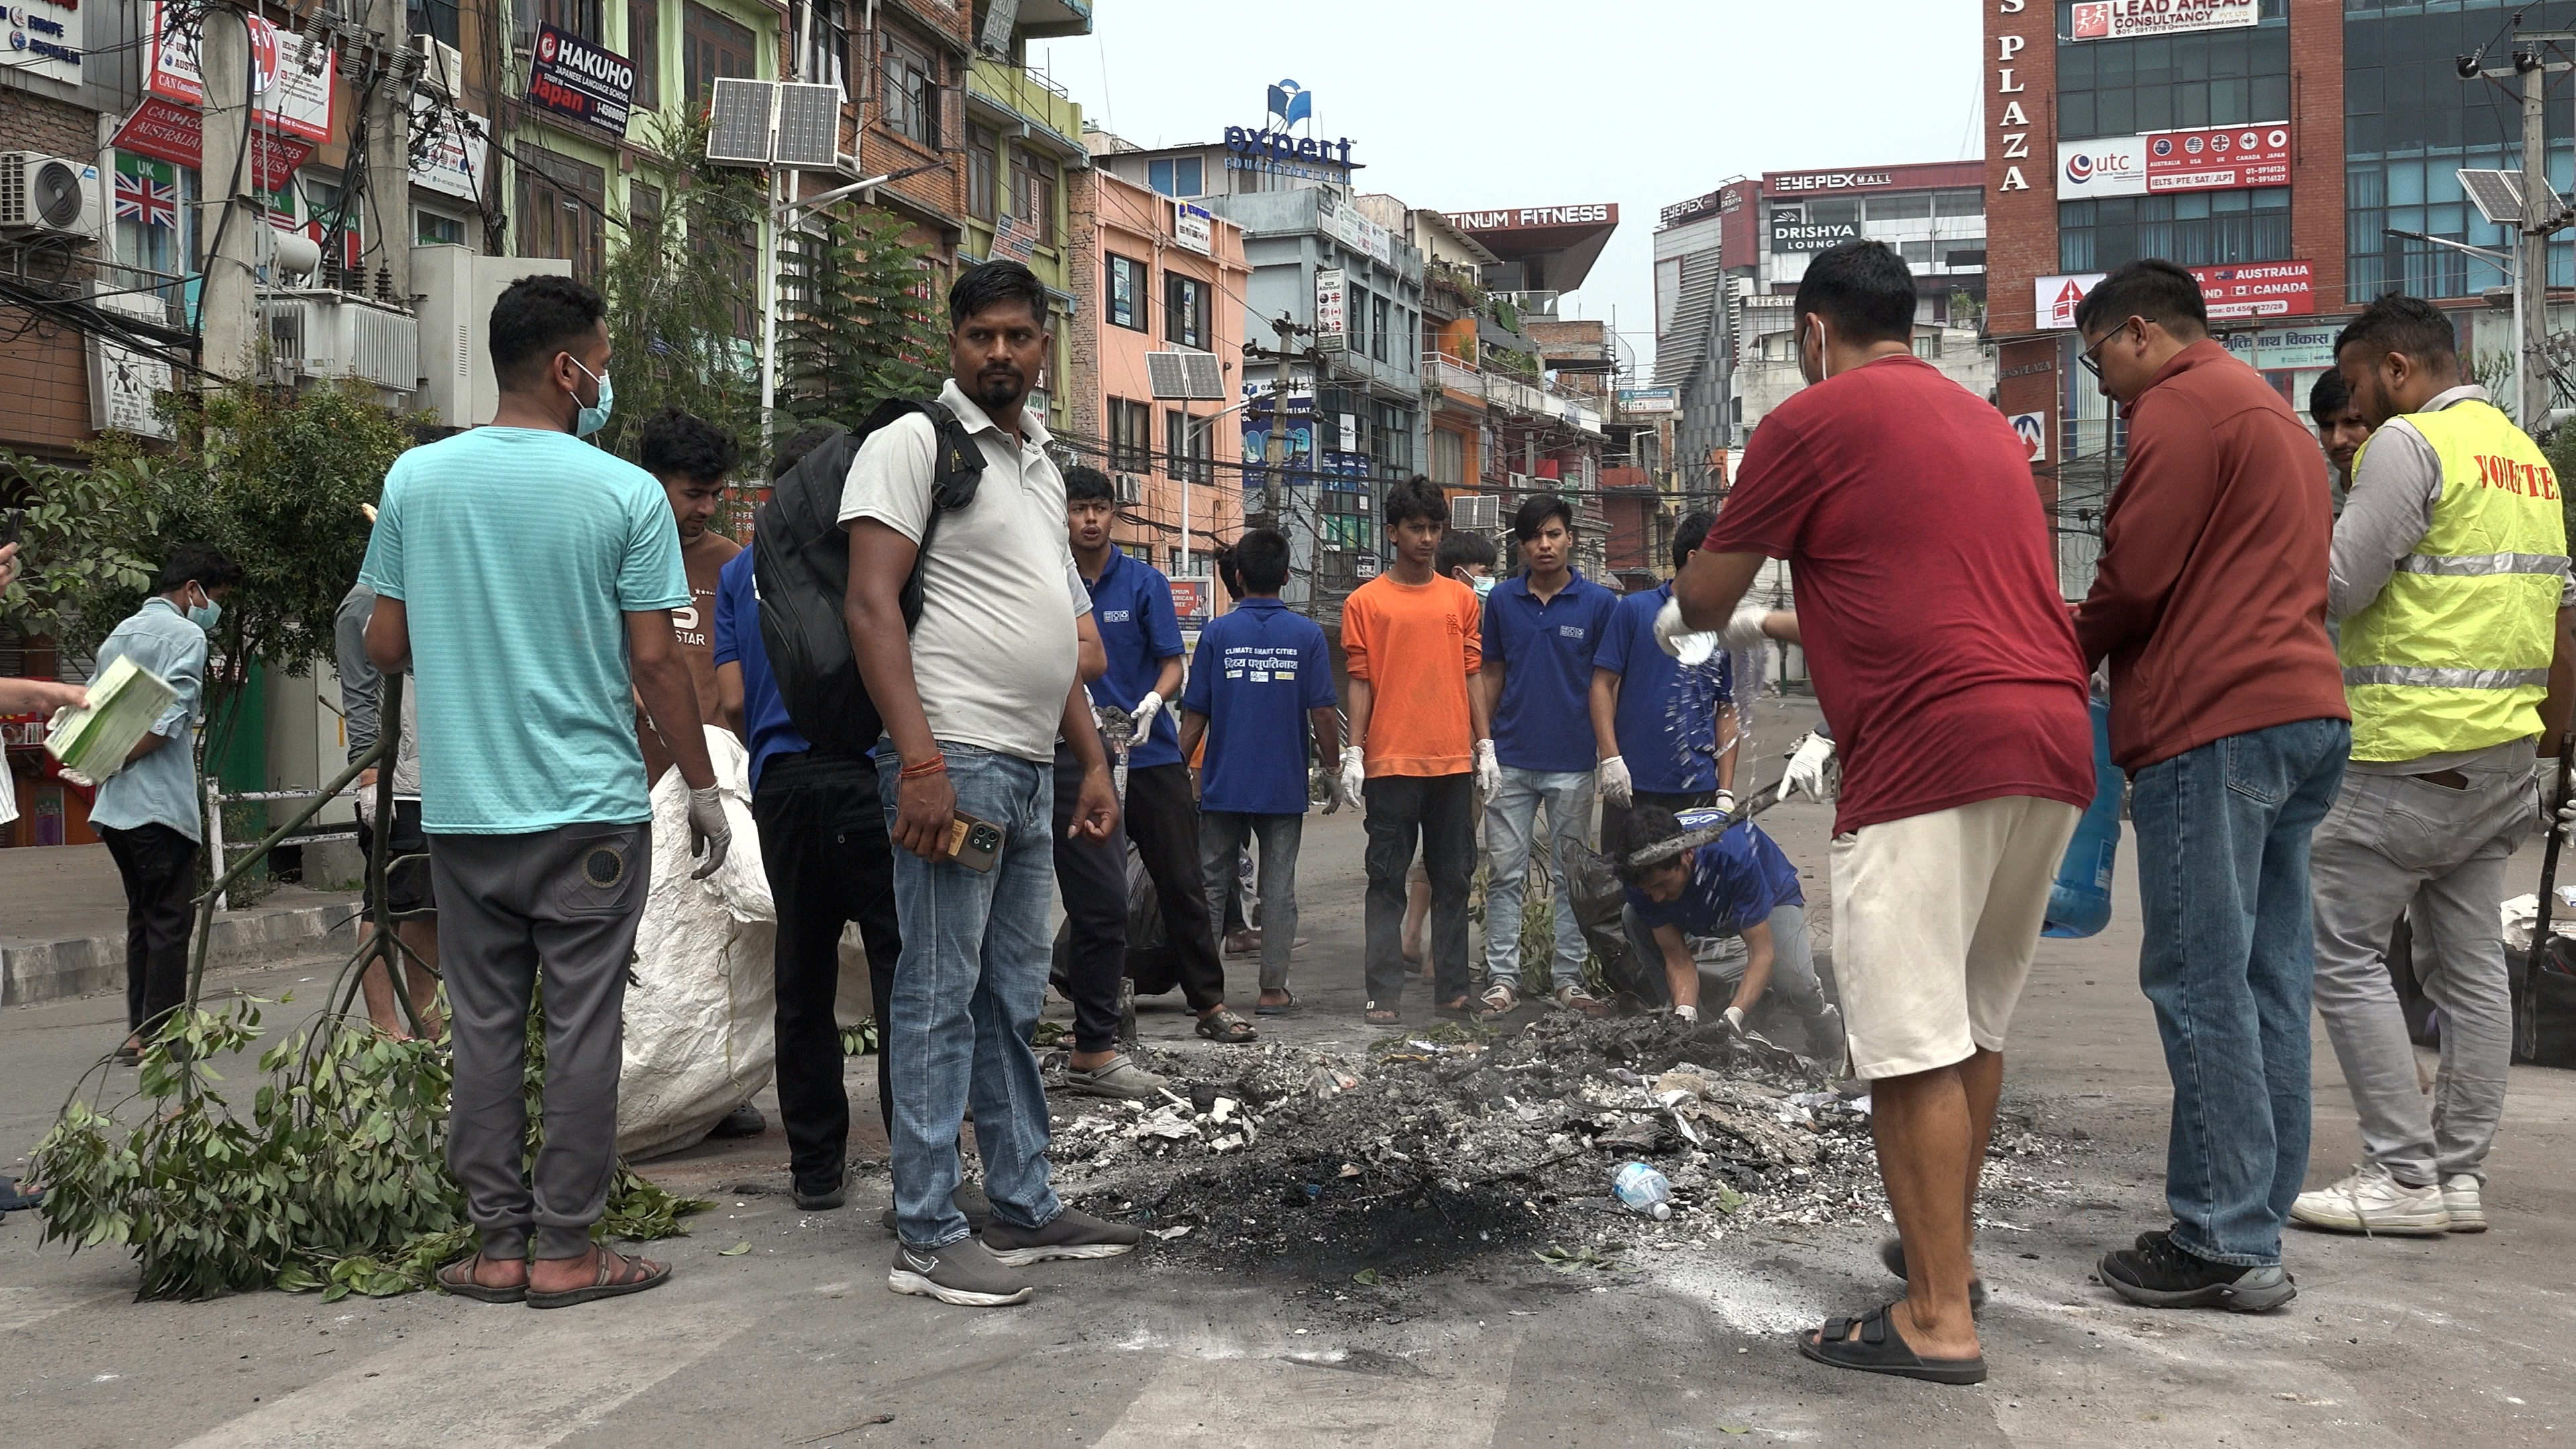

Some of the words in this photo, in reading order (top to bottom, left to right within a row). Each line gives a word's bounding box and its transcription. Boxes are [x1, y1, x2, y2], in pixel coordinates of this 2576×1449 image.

[2112, 0, 2169, 17] LEAD
[28, 15, 64, 38] EUROPE
[986, 14, 1011, 43] GATE
[2114, 11, 2212, 29] CONSULTANCY
[29, 38, 80, 65] AUSTRALIA
[175, 58, 201, 74] AUSTR
[557, 39, 633, 90] HAKUHO
[158, 74, 176, 89] CAN
[543, 72, 557, 85] STUDY
[557, 78, 564, 87] IN
[555, 65, 582, 83] JAPANESE
[582, 76, 609, 95] LANGUAGE
[609, 87, 629, 103] SCHOOL
[532, 73, 584, 112] Japan
[1998, 36, 2029, 191] PLAZA
[1224, 126, 1351, 168] expert
[137, 160, 154, 177] UK
[1224, 157, 1307, 178] EDUCATION
[1320, 171, 1352, 184] VISA
[2096, 153, 2129, 172] utc
[2245, 166, 2286, 175] 01-5916126
[1776, 173, 1856, 191] EYEPLEX
[1857, 174, 1892, 184] MALL
[2246, 174, 2286, 184] 01-5916127
[258, 191, 282, 209] USA
[1721, 196, 1742, 209] DRISHYA
[1520, 205, 1607, 226] FITNESS
[1660, 197, 1705, 223] EYEPLEX
[1775, 225, 1855, 239] DRISHYA
[2235, 265, 2308, 280] AUSTRALIA
[2253, 282, 2309, 294] CANADA
[2237, 303, 2284, 312] 456127/28
[2286, 331, 2329, 346] विकास
[2019, 361, 2052, 375] PLAZA
[675, 630, 705, 646] STAR
[1225, 647, 1253, 655] CLIMATE
[1224, 657, 1246, 669] दिव्य
[1248, 657, 1299, 671] पशुपतिनाथ
